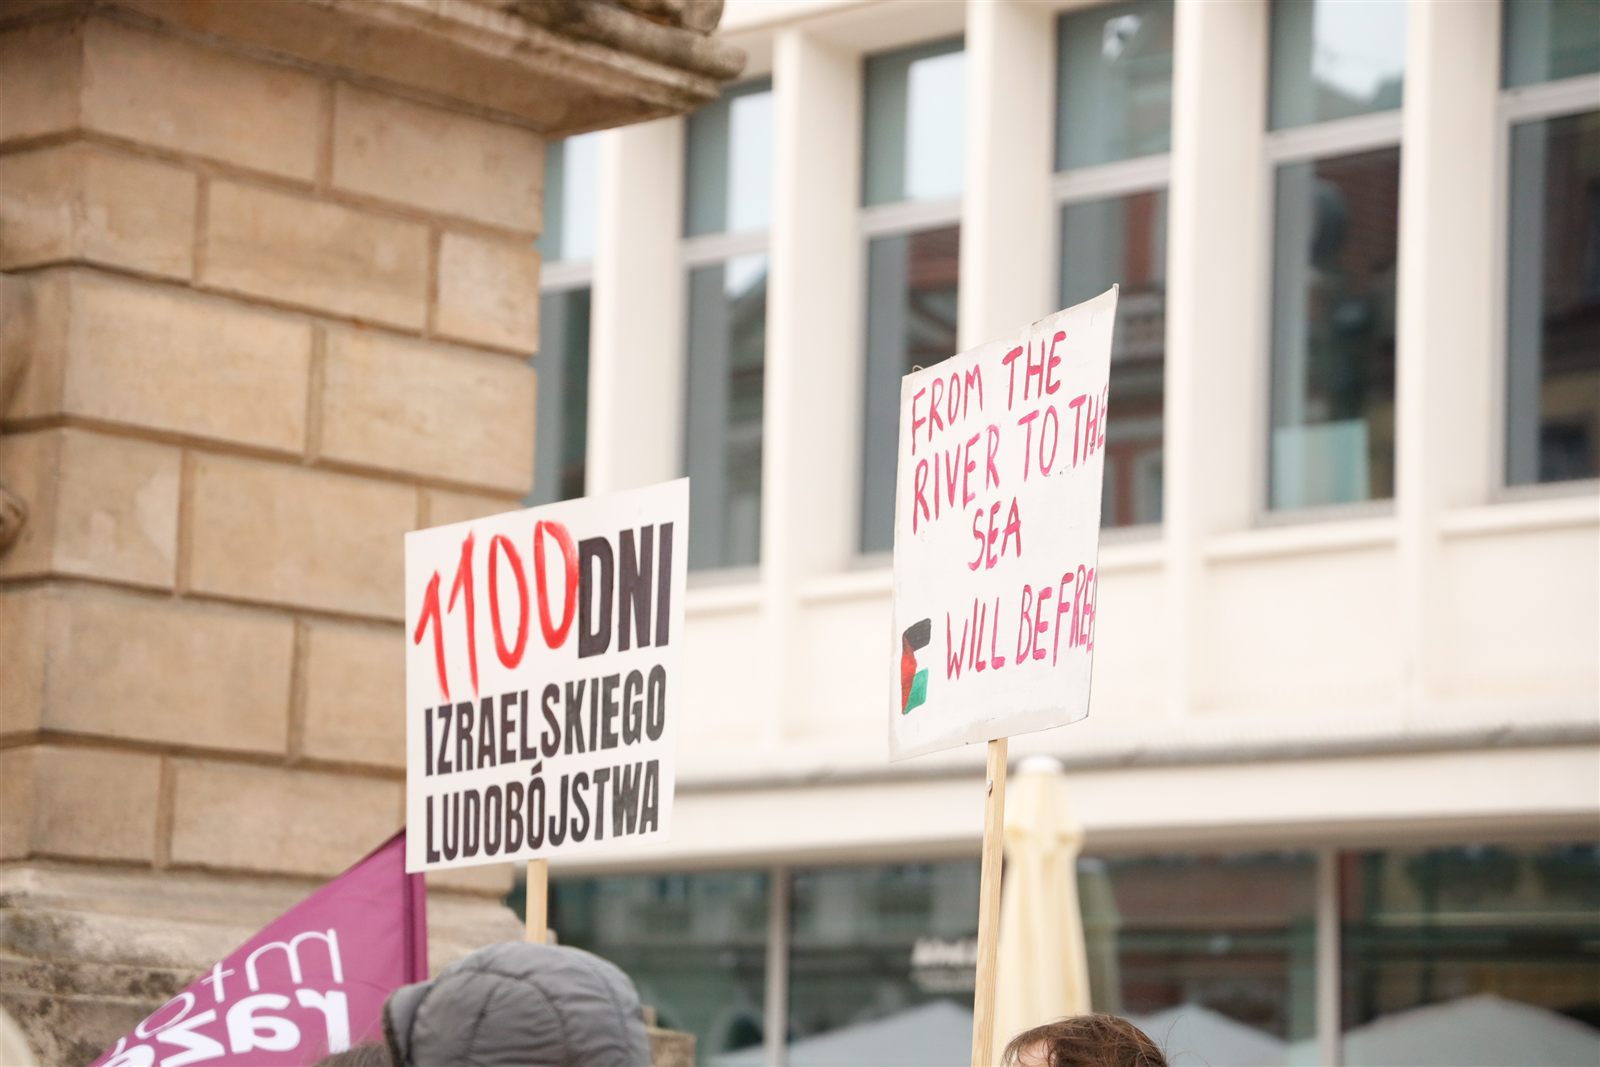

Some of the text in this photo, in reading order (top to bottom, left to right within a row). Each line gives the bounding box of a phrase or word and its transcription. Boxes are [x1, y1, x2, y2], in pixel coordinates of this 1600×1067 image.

[911, 330, 1068, 457] FROM THE
[912, 424, 1001, 536] RIVER
[1017, 404, 1059, 482] TO
[967, 496, 1022, 572] SEA
[413, 519, 675, 703] 1100 DNI
[946, 596, 1006, 681] WILL
[425, 663, 667, 777] IZRAELSKIEGO
[425, 759, 660, 864] LUDOBÓJSTWA
